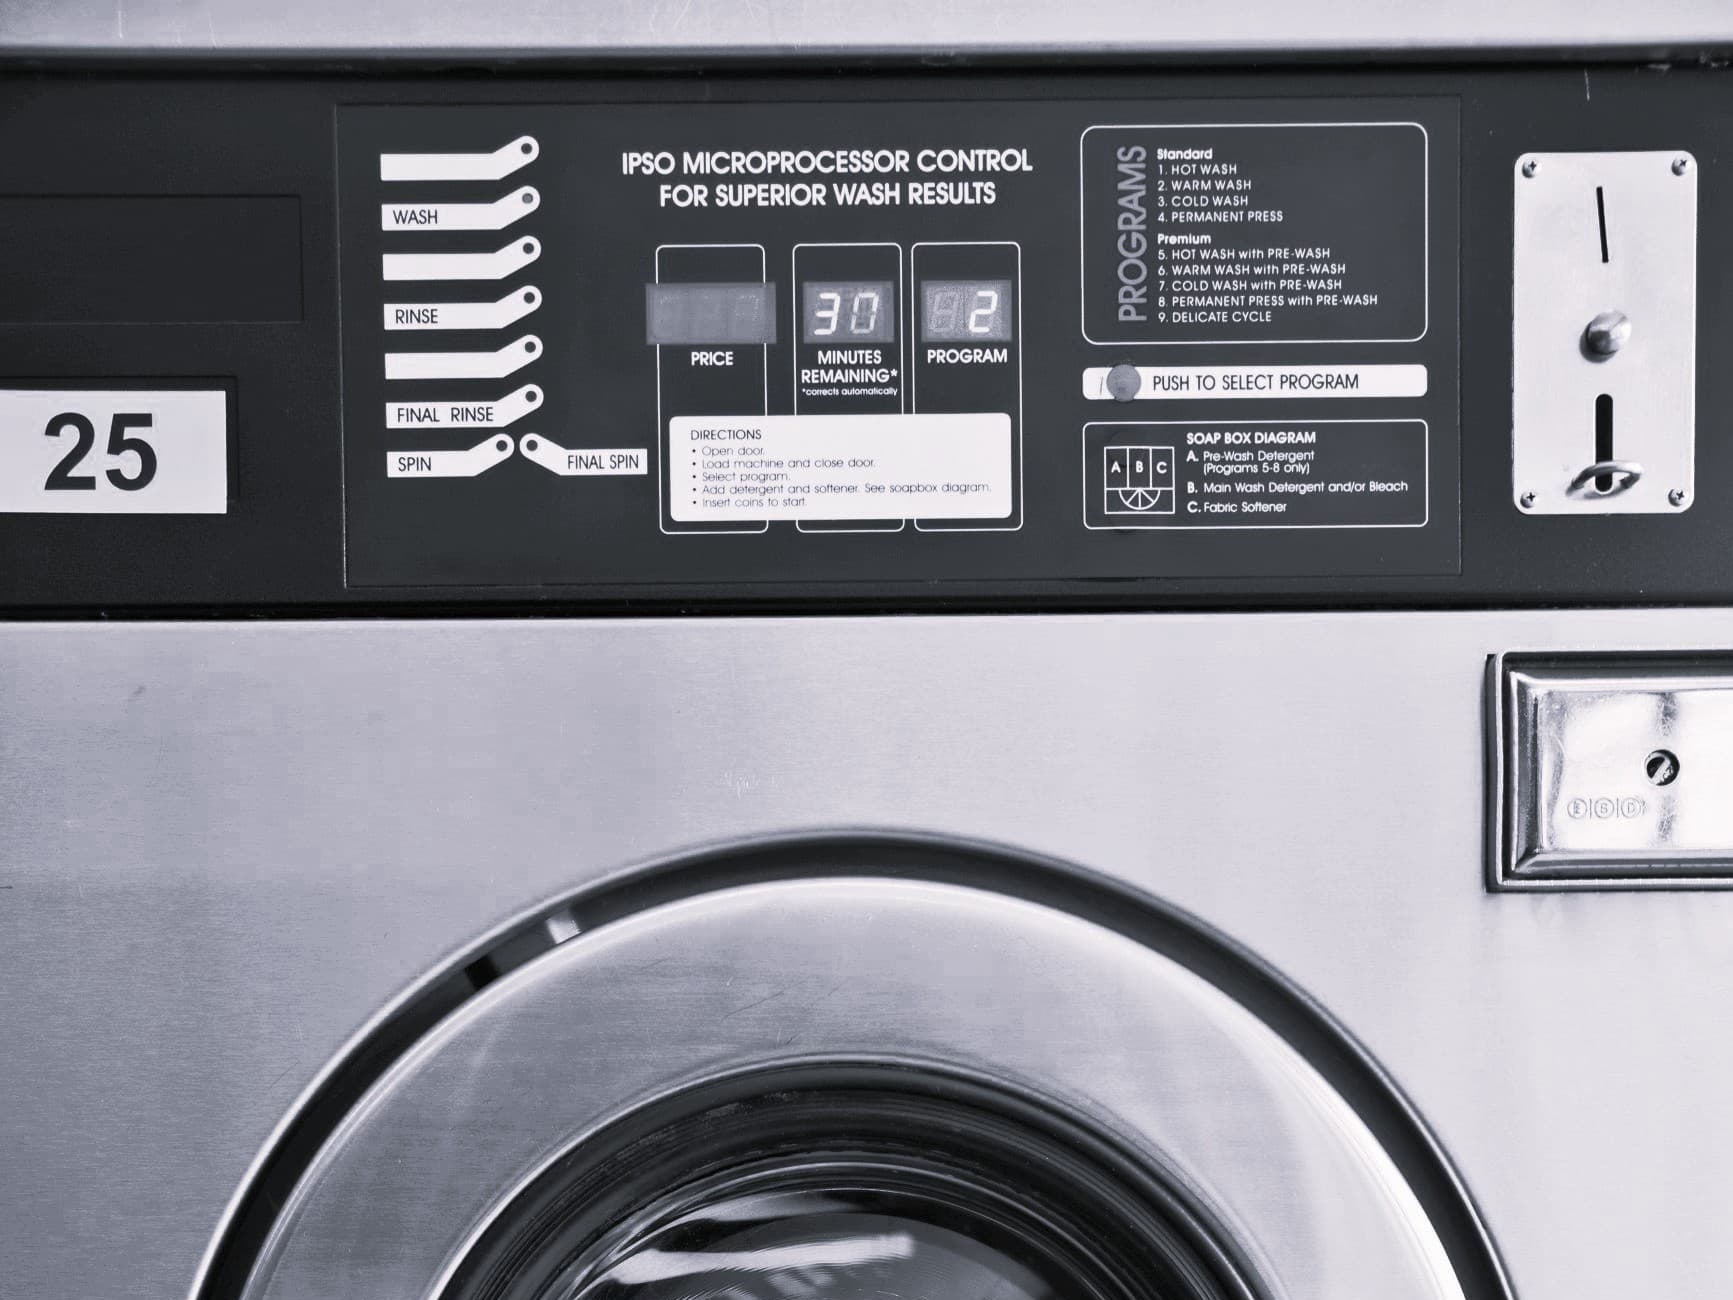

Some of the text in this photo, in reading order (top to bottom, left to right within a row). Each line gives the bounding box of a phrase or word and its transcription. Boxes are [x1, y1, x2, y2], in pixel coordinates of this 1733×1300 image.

[1158, 149, 1212, 159] Standard
[623, 149, 1033, 174] IPSO MICROPROCESSOR CONTROL
[1159, 164, 1236, 175] 1. HOT WASH
[1158, 180, 1251, 191] 2. WARM WASH
[661, 182, 995, 207] FOR SUPERIOR WASH RESULTS
[1158, 196, 1248, 207] 3. COLD WASH
[393, 210, 437, 224] WASH
[1158, 211, 1283, 222] 4. PERMANENT PRESS
[1117, 146, 1147, 320] PROGRAMS
[1158, 234, 1211, 244] Premium
[1158, 248, 1329, 260] 5. HOT WASH with PRE-WASH
[1158, 264, 1345, 276] 6. WARM WASH with PRE-WASH
[1159, 279, 1341, 291] 7. COLD WASH with PRE-WASH
[1173, 296, 1245, 307] PERMANENT
[1249, 296, 1284, 306] PRESS
[1288, 296, 1312, 305] with
[1317, 294, 1377, 305] PRE-WASH
[396, 309, 438, 324] RINSE
[814, 292, 879, 335] 30
[1159, 311, 1271, 323] 9. DELICATE CYCLE
[692, 352, 733, 365] PRICE
[818, 350, 881, 364] MINUTES
[928, 349, 1007, 363] PROGRAM
[1153, 374, 1358, 391] PUSH TO SELECT PROGRAM
[842, 387, 897, 397] automatically
[398, 407, 493, 422] FINAL RINSE
[691, 429, 761, 440] DIRECTIONS
[1187, 432, 1315, 444] SOAP BOX DIAGRAM
[44, 412, 157, 491] 25
[702, 446, 733, 457] Open
[1187, 450, 1314, 464] A. Pre-Wash Detergent
[399, 457, 431, 472] SPIN
[568, 455, 638, 469] FINAL SPIN
[703, 460, 729, 469] Load
[734, 459, 783, 468] machine
[788, 460, 810, 468] and
[815, 459, 844, 468] close
[1111, 461, 1167, 474] A B C
[1204, 462, 1309, 475] (Programs 5-8 only)
[703, 472, 790, 484] Select program.
[703, 485, 725, 494] Add
[730, 484, 783, 496] detergent
[788, 485, 810, 494] and
[865, 484, 885, 493] See
[890, 483, 937, 494] soapbox
[1188, 481, 1408, 494] B. Main Wash Detergent and/or Bleach
[703, 498, 730, 507] Insert
[735, 498, 763, 507] coins
[768, 498, 778, 506] to
[1187, 501, 1287, 513] C. Fabric Softener
